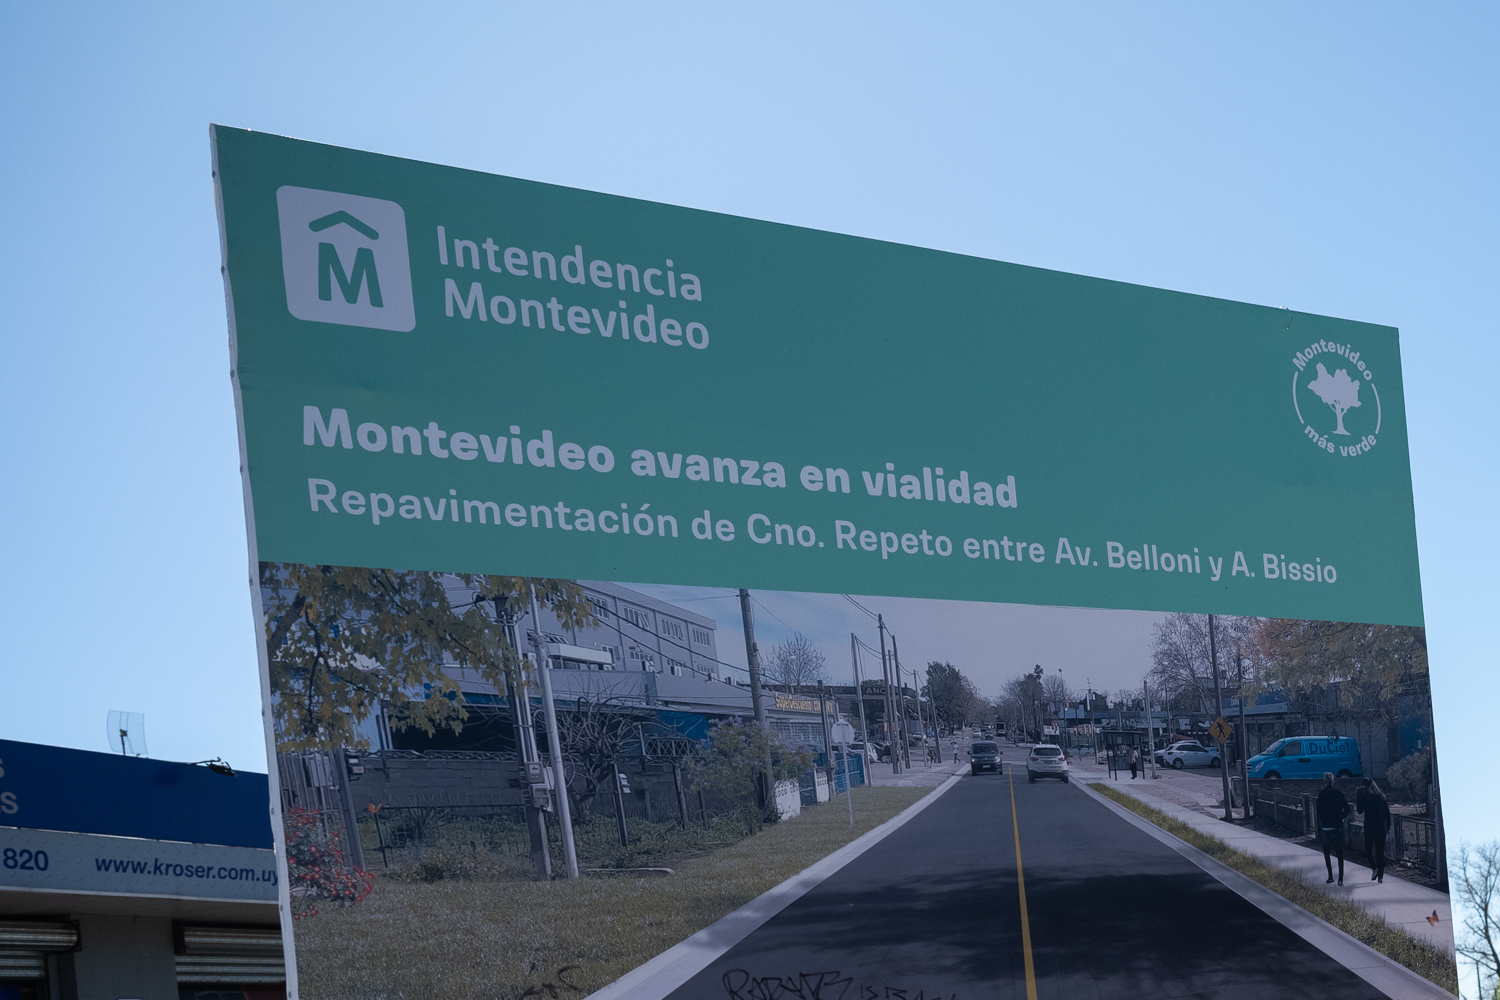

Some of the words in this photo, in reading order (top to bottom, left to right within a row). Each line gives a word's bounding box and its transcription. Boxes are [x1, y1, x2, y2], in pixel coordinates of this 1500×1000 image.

[437, 225, 702, 302] Intendencia
[444, 278, 710, 350] Montevideo
[1292, 338, 1373, 381] Montevideo
[303, 405, 615, 473] Montevideo
[630, 449, 787, 489] avanza
[799, 465, 851, 494] en
[861, 462, 1018, 509] vialidad
[1303, 425, 1335, 454] más
[1339, 434, 1377, 457] verde
[308, 478, 679, 538] Repavimentación
[691, 509, 736, 542] de
[747, 513, 825, 548] Cno.
[834, 519, 953, 560] Repeto
[963, 535, 1046, 563] entre
[1055, 537, 1098, 567] Av.
[1106, 541, 1201, 574] Belloni
[1208, 556, 1223, 582] y
[1231, 550, 1256, 578] A.
[1262, 552, 1338, 584] Bissio
[3, 847, 49, 871] 820
[95, 857, 278, 886] www.kroser.com.uy
[861, 986, 878, 1000] IS
